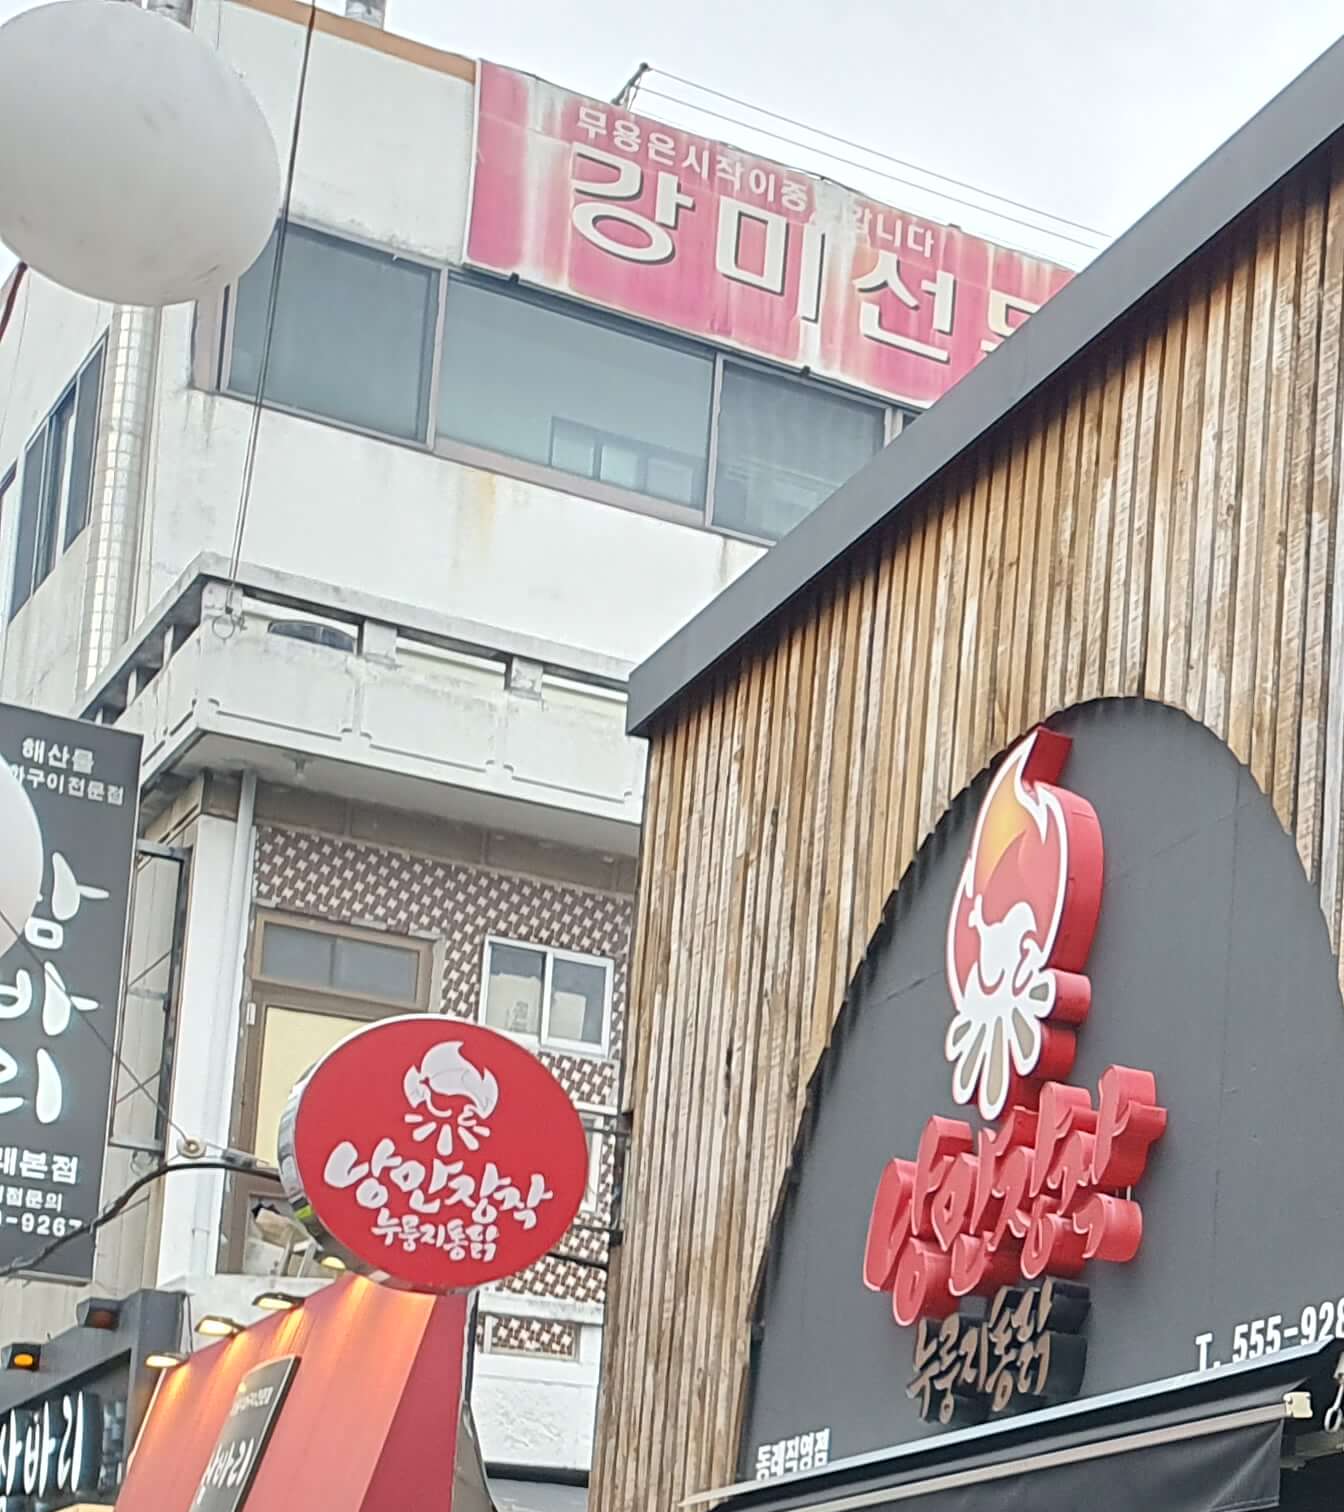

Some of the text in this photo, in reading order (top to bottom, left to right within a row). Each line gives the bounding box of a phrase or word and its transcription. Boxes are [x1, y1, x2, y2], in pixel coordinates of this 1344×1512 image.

[0, 1209, 83, 1237] -9267
[370, 1207, 500, 1262] 누룽지통닭
[904, 1277, 1072, 1426] 누룽지통닭
[1195, 1313, 1222, 1371] T.
[755, 1427, 831, 1481] 동래직영점
